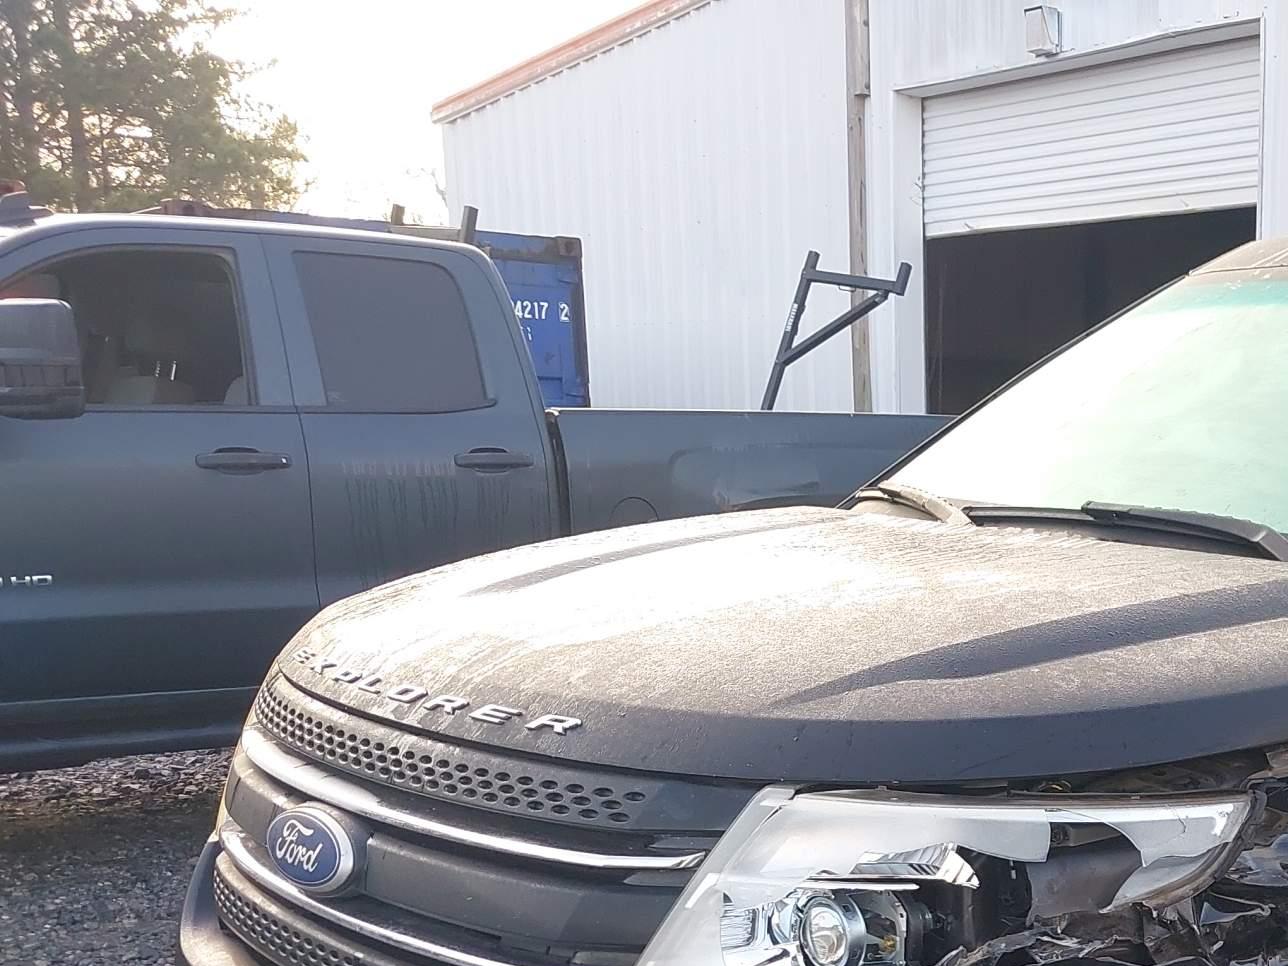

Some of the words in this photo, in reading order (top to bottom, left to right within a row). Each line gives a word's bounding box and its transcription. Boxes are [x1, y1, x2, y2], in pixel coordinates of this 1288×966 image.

[559, 303, 570, 321] 2
[10, 575, 52, 587] HD
[292, 647, 583, 736] EXPLORER
[276, 820, 323, 872] Ford
